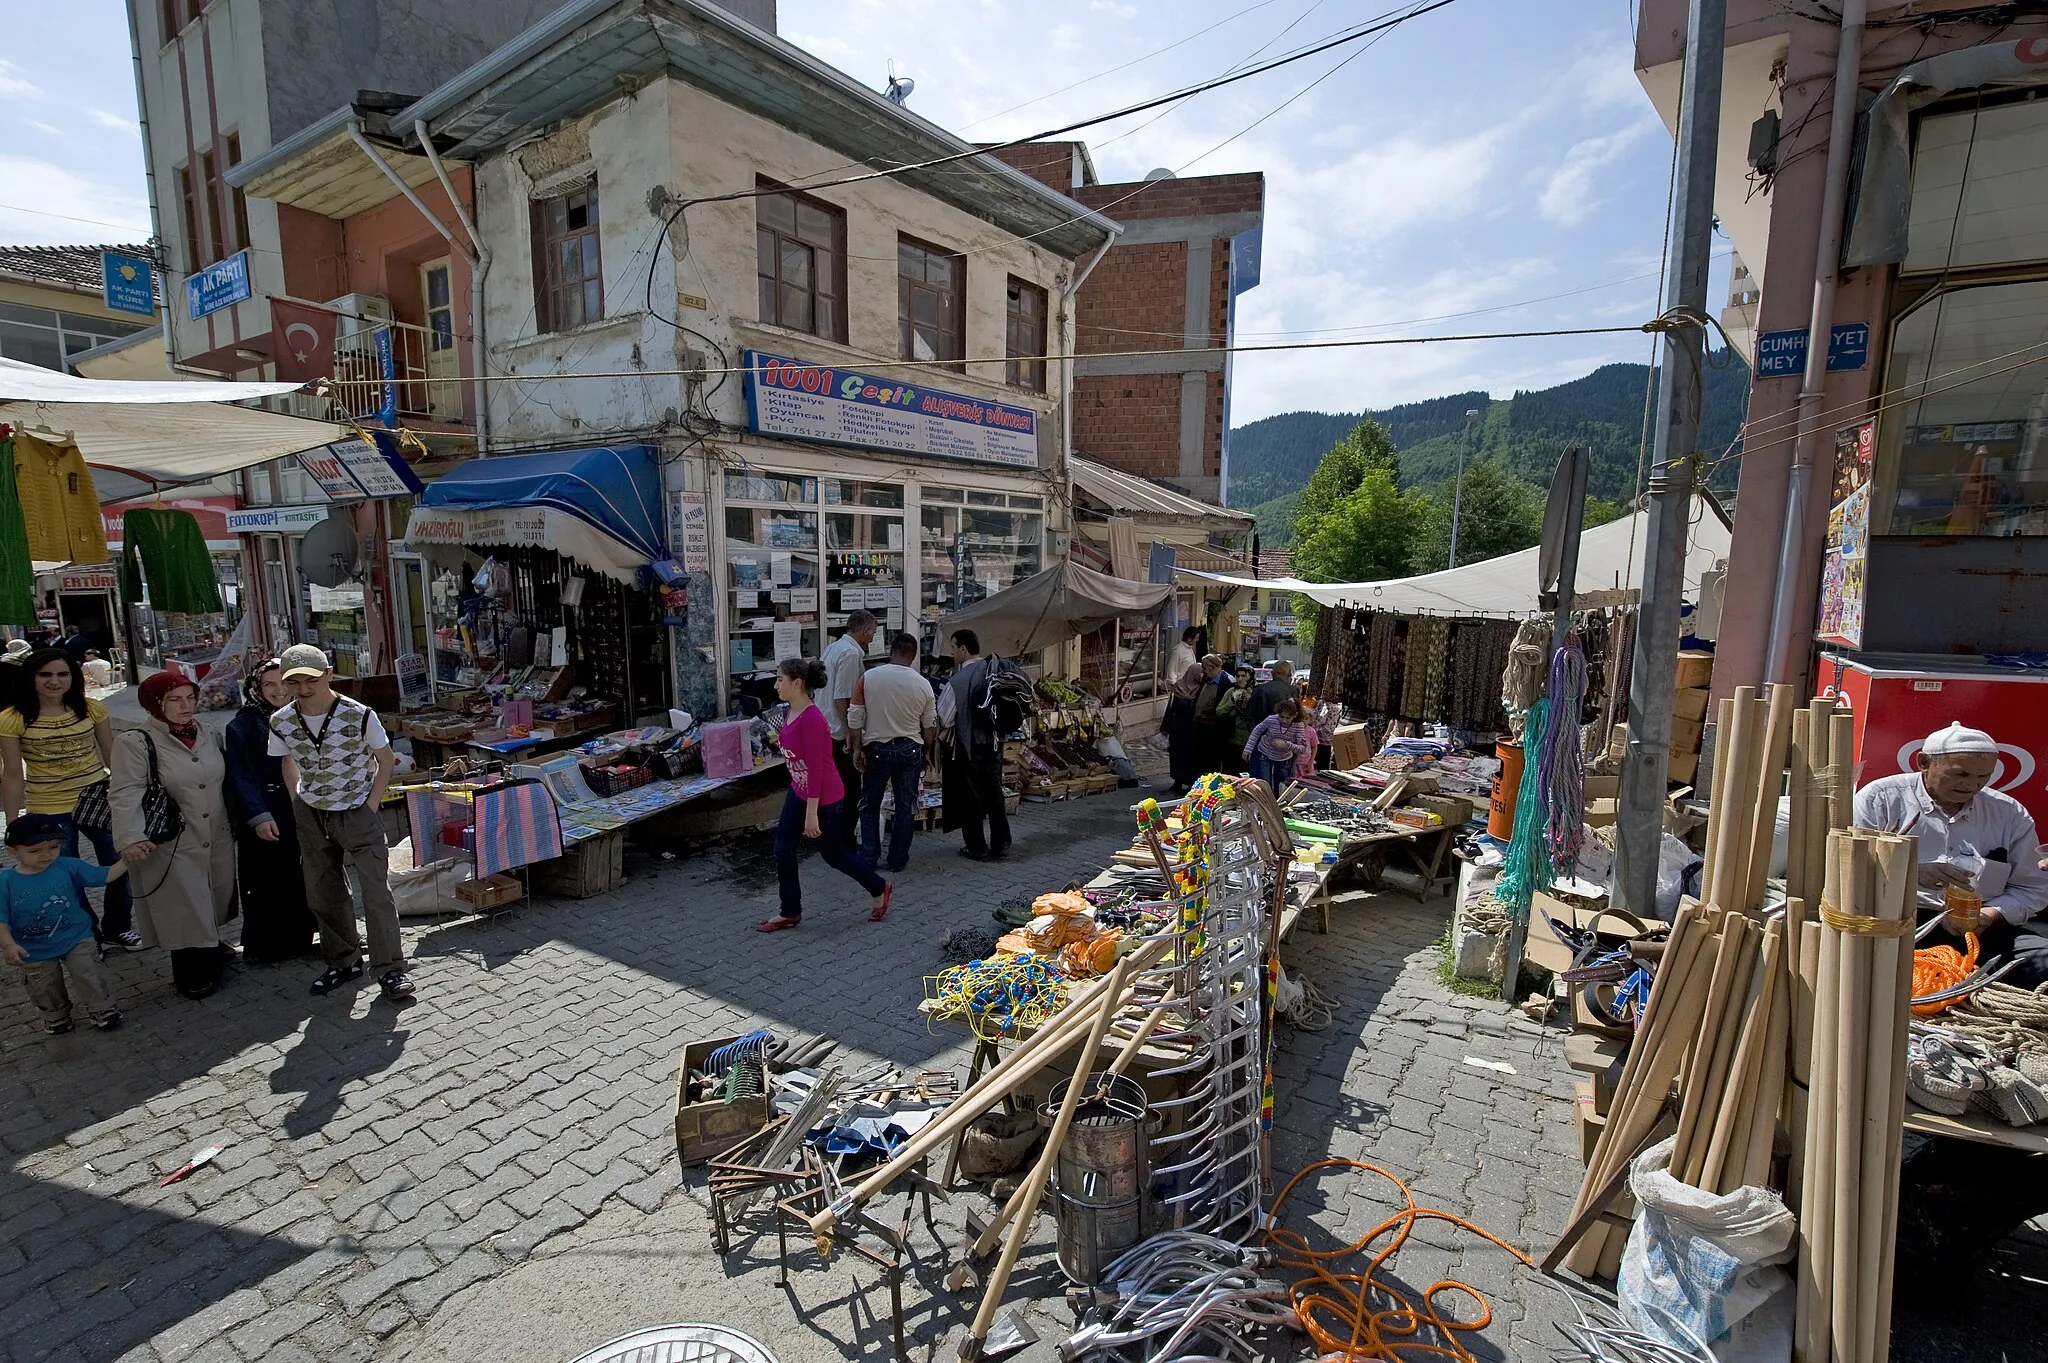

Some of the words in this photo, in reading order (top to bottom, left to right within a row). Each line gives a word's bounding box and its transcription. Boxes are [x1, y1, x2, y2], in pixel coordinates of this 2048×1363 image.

[202, 274, 214, 293] AK
[216, 258, 243, 287] PARTİ
[111, 284, 123, 292] AK
[117, 293, 144, 305] KÜRE
[1760, 330, 1867, 353] CUMHYET
[766, 359, 833, 396] 1001
[841, 376, 915, 405] Çeşit
[768, 390, 825, 406] Kırtasiye
[768, 398, 802, 410] Kitap
[769, 406, 826, 423] Oyuncak
[842, 404, 885, 418] Fotokopi
[922, 395, 984, 424] ALIŞVERİŞ
[985, 406, 1031, 431] DÜNYASI
[842, 411, 874, 423] Renkli
[876, 417, 915, 430] Fotokopi
[843, 418, 887, 432] Hediyelik
[889, 426, 911, 437] Eşya
[764, 423, 782, 432] Tel
[792, 426, 811, 436] 751
[815, 429, 827, 439] 27
[830, 431, 842, 440] 27
[844, 425, 878, 438] Bijuteri
[849, 435, 867, 444] Fax
[874, 438, 889, 447] 751
[892, 440, 903, 448] 20
[905, 441, 916, 450] 22
[107, 514, 125, 531] voda
[229, 511, 279, 527] FOTOKOPİ
[401, 657, 422, 667] STAR
